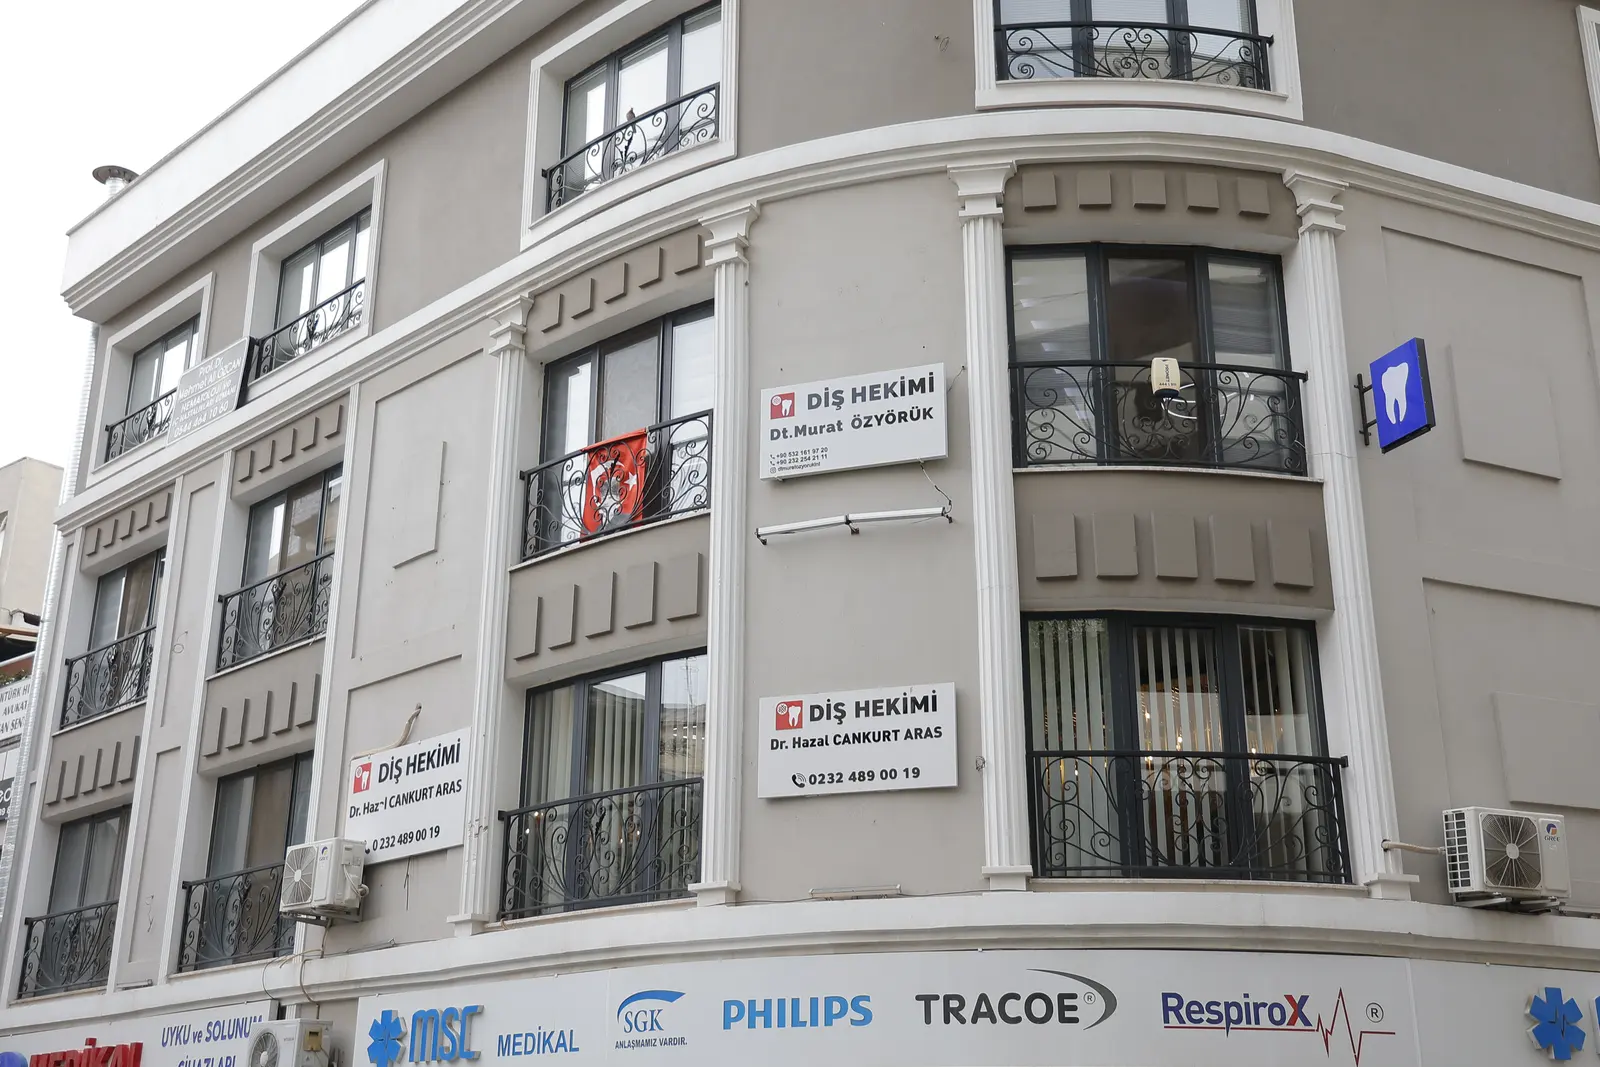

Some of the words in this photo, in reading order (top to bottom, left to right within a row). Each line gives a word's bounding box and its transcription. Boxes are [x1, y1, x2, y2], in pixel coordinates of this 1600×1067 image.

[807, 387, 845, 410] DİŞ
[851, 372, 934, 404] HEKİMİ
[770, 420, 843, 441] Dt.Murat
[851, 407, 933, 429] ÖZYÖRÜK
[809, 698, 847, 725] DİŞ
[855, 689, 938, 718] HEKİMİ
[770, 738, 789, 750] Dr.
[792, 734, 829, 749] Hazal
[833, 729, 900, 746] CANKURT
[904, 726, 943, 740] ARAS
[378, 756, 403, 784] DİŞ
[405, 738, 461, 776] HEKİMİ
[808, 772, 844, 785] 0232
[848, 770, 875, 783] 489
[880, 768, 898, 781] 00
[903, 767, 921, 779] 19
[349, 805, 361, 818] Dr.
[389, 786, 434, 808] CANKURT
[435, 779, 462, 798] ARAS
[372, 838, 378, 851] 0
[379, 835, 396, 850] 232
[397, 831, 414, 845] 489
[415, 828, 427, 841] 00
[429, 825, 440, 839] 19
[624, 1009, 664, 1033] SGK
[722, 995, 873, 1030] PHILIPS
[915, 992, 1080, 1025] TRACOE
[1161, 992, 1313, 1038] RespiroX
[161, 1024, 191, 1047] UYKU
[192, 1030, 203, 1044] ve
[205, 1015, 263, 1042] SOLUNU
[497, 1026, 580, 1057] MEDİKAL
[615, 1038, 657, 1050] ANLAŞMAMIZ
[659, 1037, 688, 1046] VARDIR.
